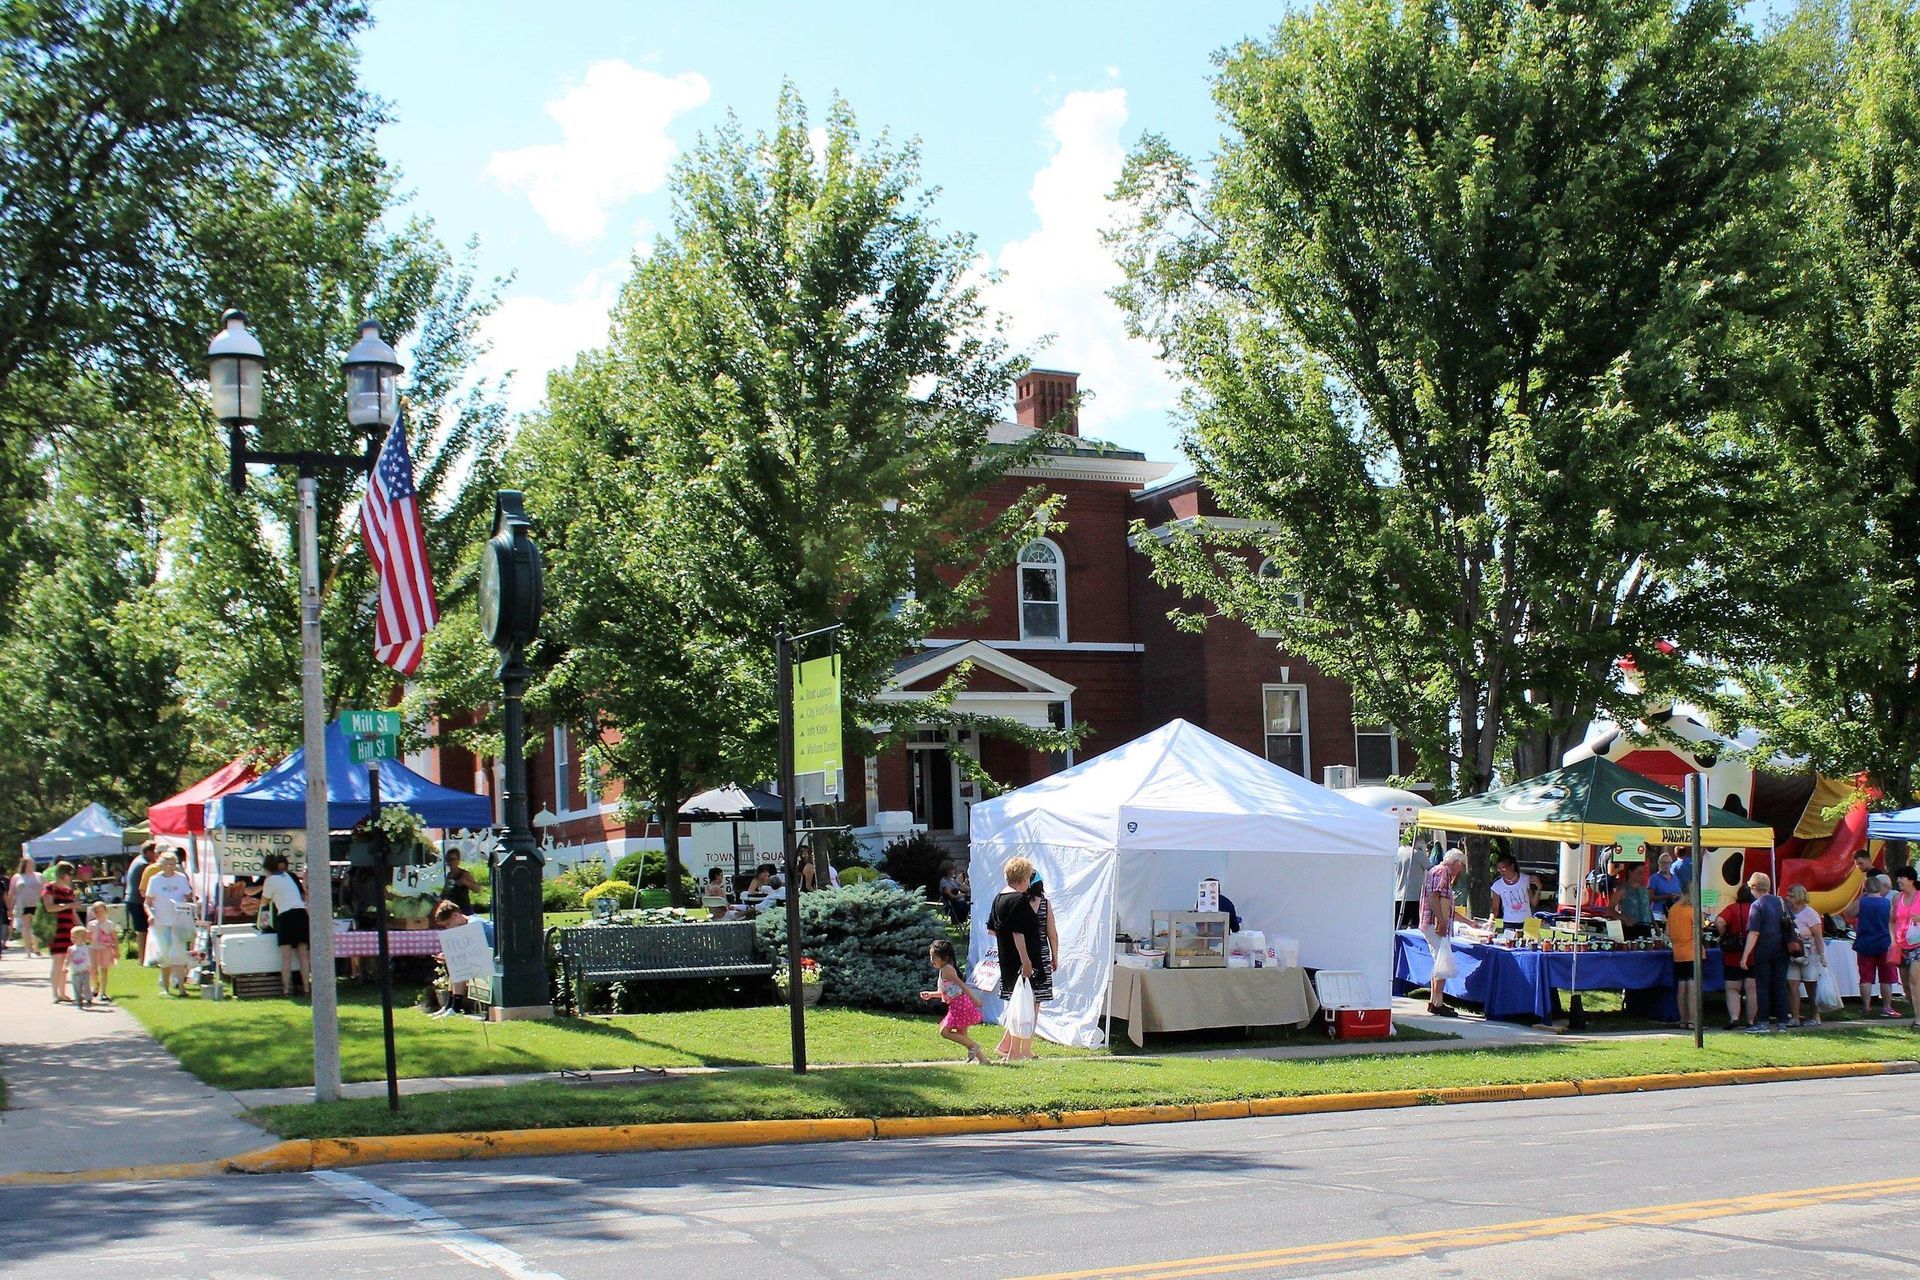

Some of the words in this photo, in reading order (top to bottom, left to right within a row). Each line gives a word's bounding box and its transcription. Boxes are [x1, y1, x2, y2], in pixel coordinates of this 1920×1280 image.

[352, 714, 373, 732] Mill
[376, 714, 389, 732] St
[357, 741, 373, 759] Hill
[376, 738, 386, 757] St
[1616, 789, 1685, 818] G
[214, 832, 293, 844] CERTIFIED
[1662, 829, 1694, 842] PACKE
[223, 846, 291, 857] ORGANIC
[705, 852, 734, 862] TOWN
[756, 851, 785, 862] SQUA
